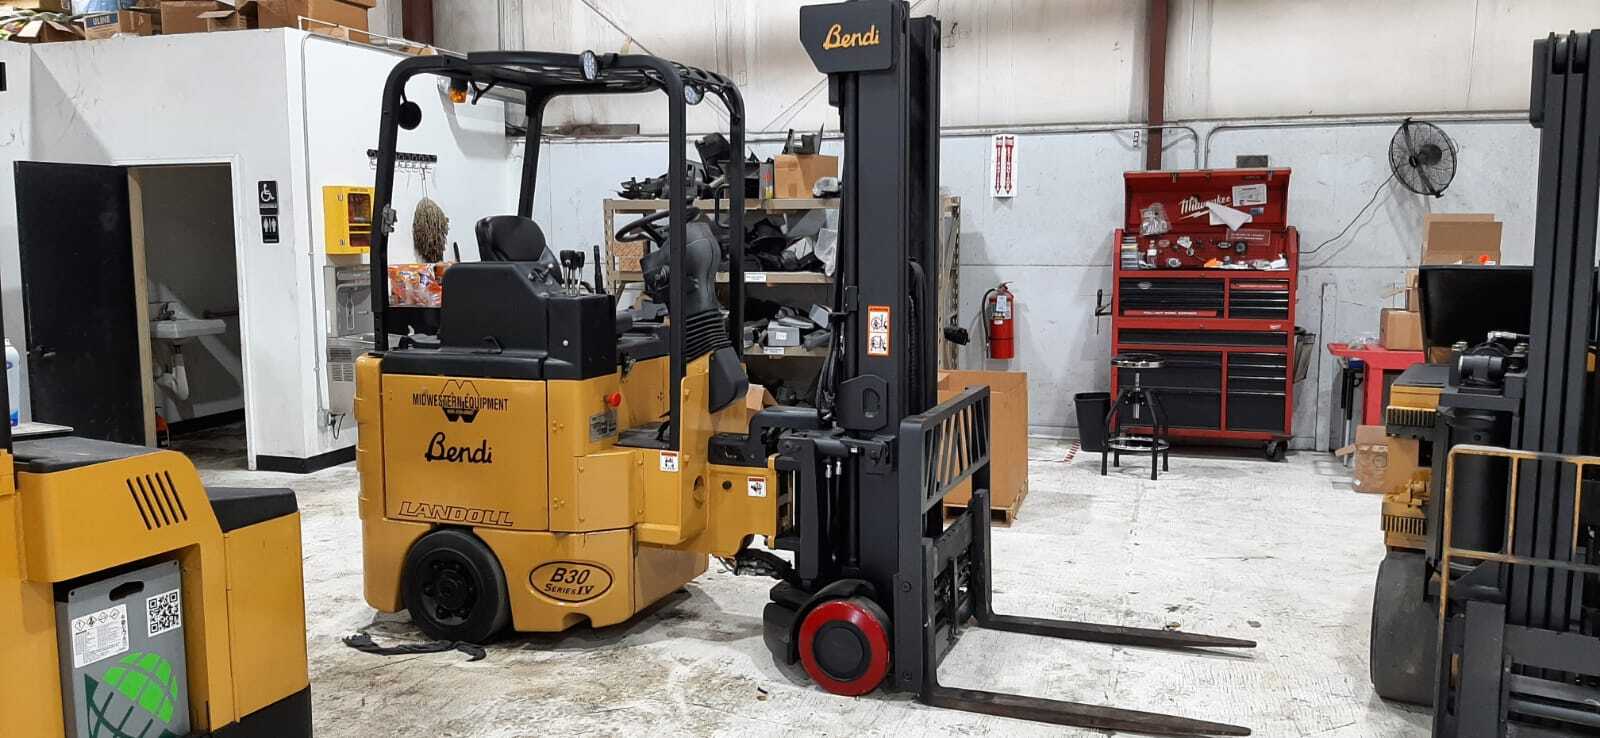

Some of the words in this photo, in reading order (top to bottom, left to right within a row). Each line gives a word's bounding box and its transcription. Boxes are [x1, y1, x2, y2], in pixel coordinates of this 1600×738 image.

[822, 23, 880, 50] Bendi
[1178, 194, 1232, 216] Milwkee
[412, 392, 462, 409] MIDWESTERN
[464, 395, 509, 411] EQUIPMENT
[424, 431, 493, 464] Bendi
[398, 501, 514, 527] LANDOLL
[550, 567, 591, 585] B30
